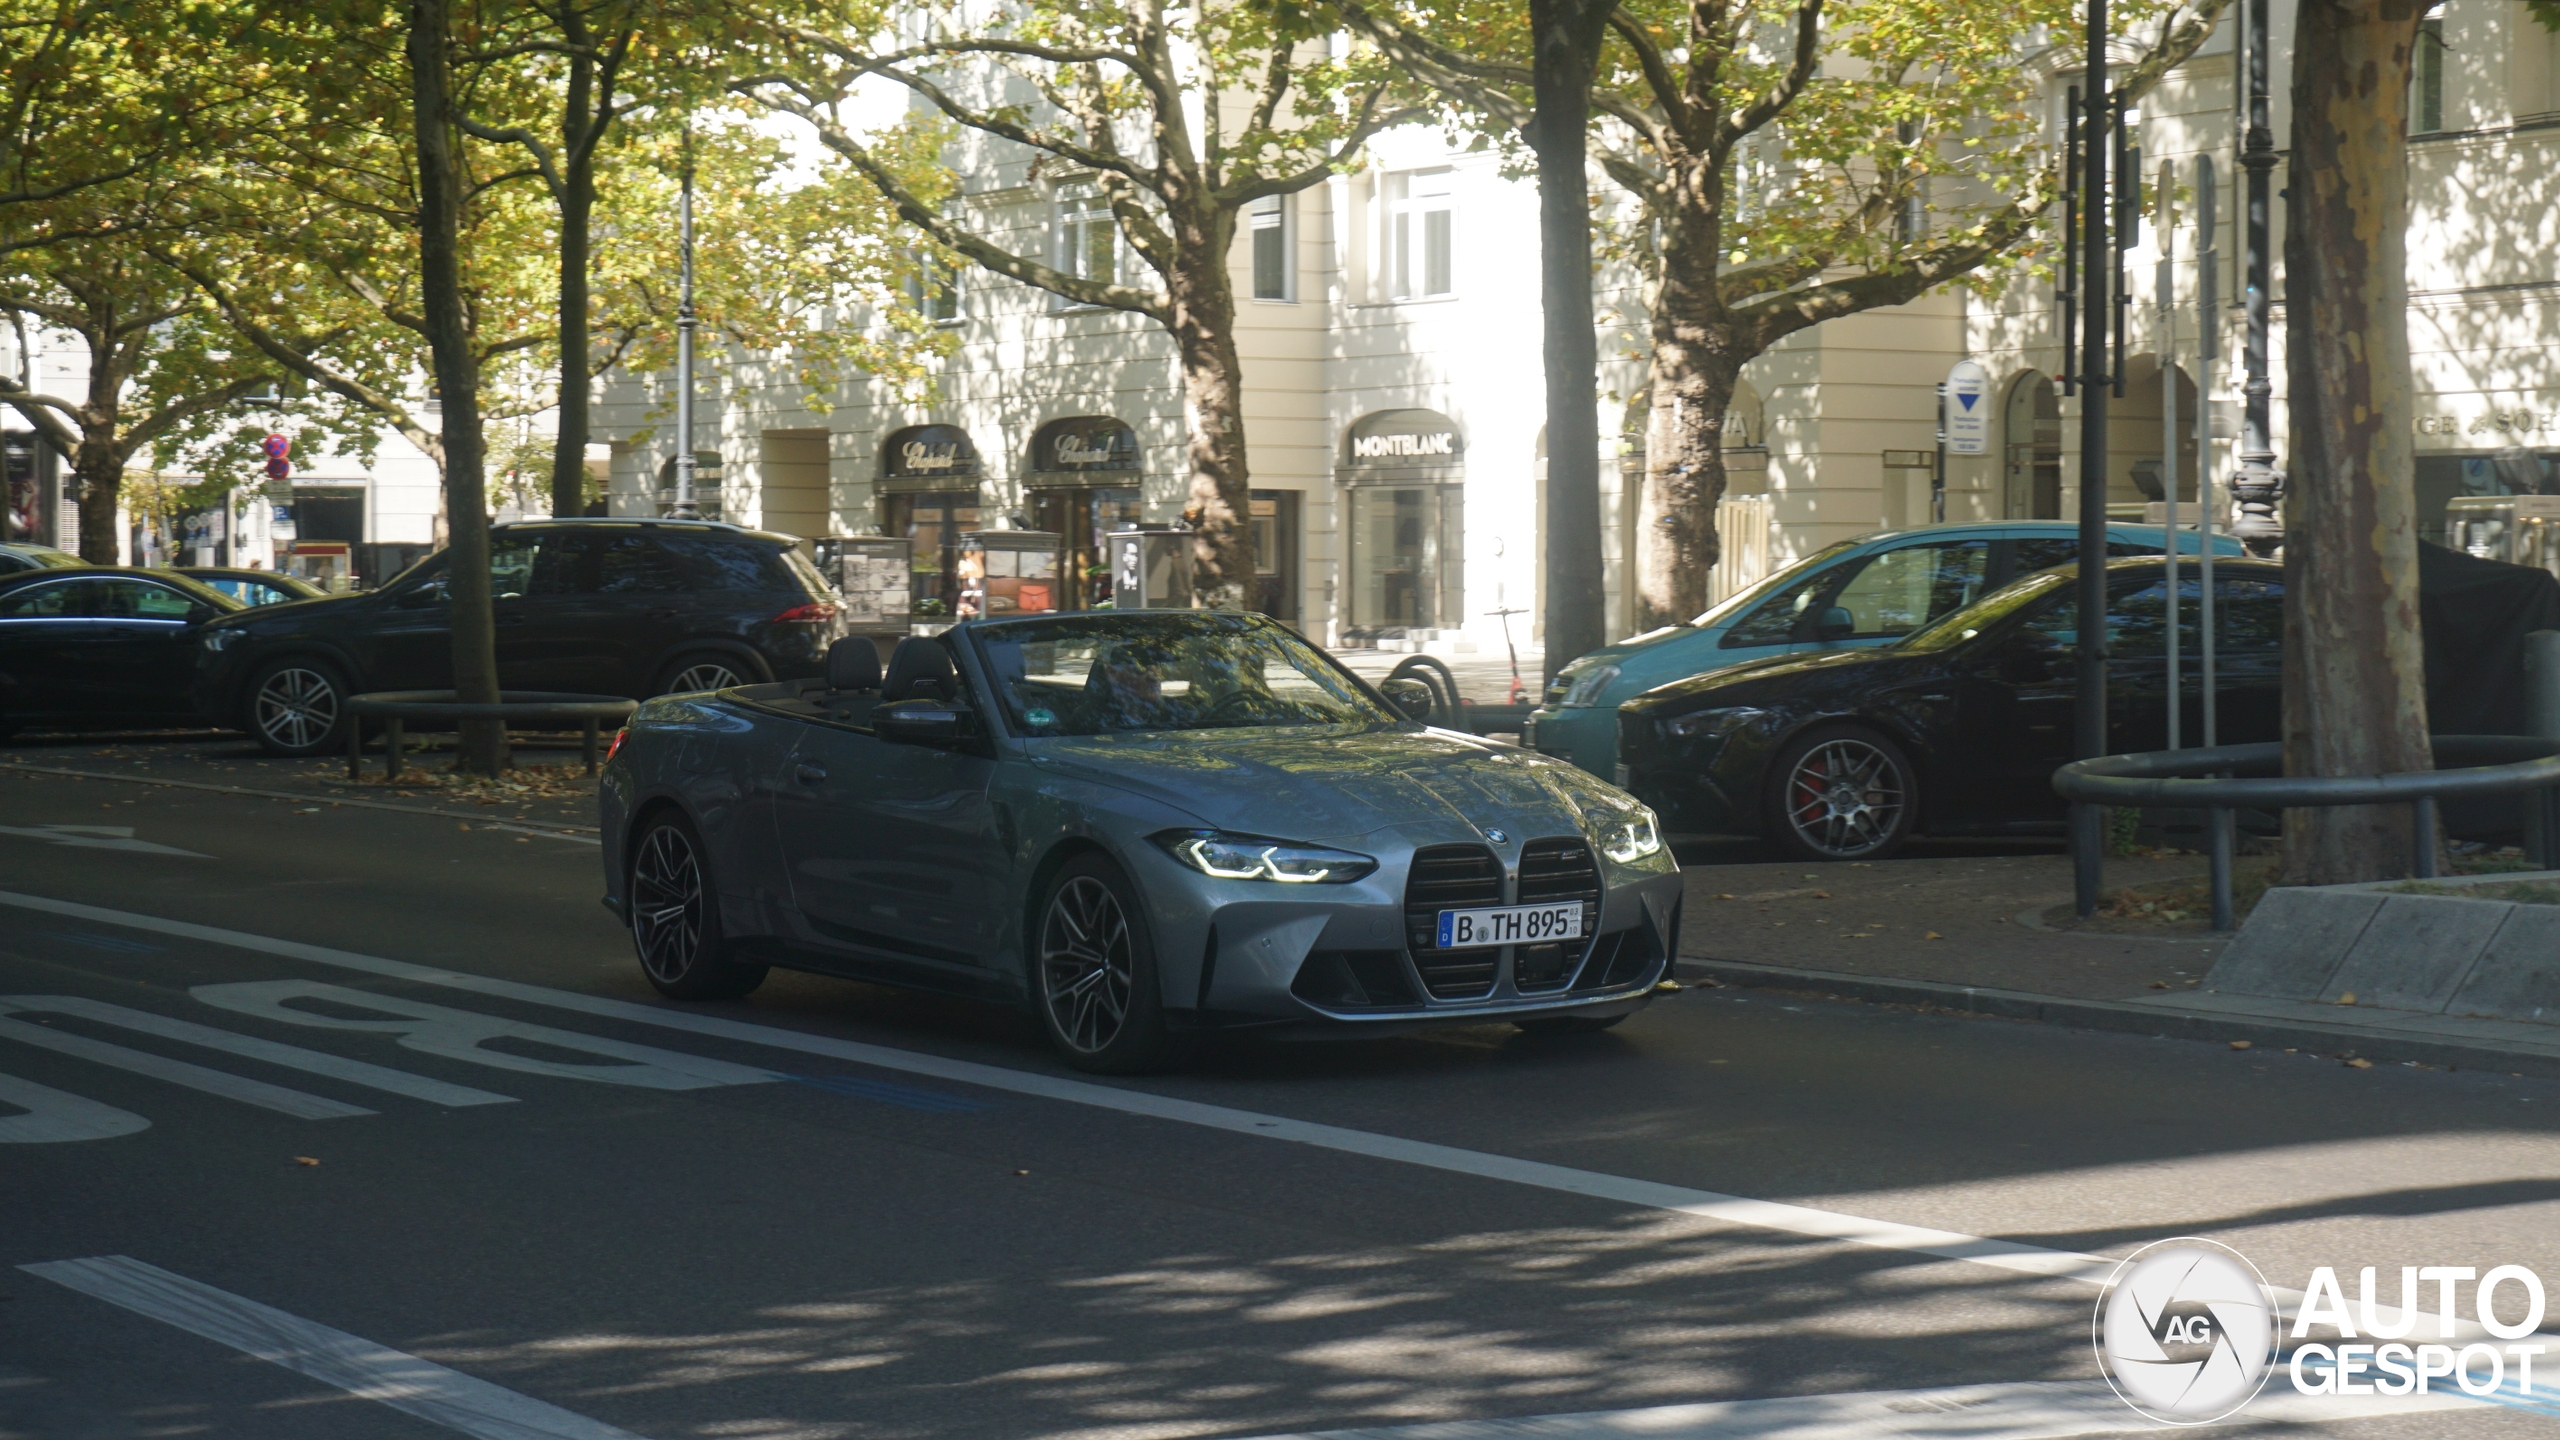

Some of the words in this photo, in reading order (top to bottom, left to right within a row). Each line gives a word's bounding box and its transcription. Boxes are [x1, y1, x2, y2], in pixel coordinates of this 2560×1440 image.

[902, 440, 957, 475] Chopard
[1054, 433, 1115, 470] Chopard
[1353, 432, 1453, 457] MONTBLANC
[1442, 933, 1449, 942] D
[1457, 915, 1473, 943] B
[1491, 912, 1522, 940] TH
[1526, 908, 1568, 938] 895
